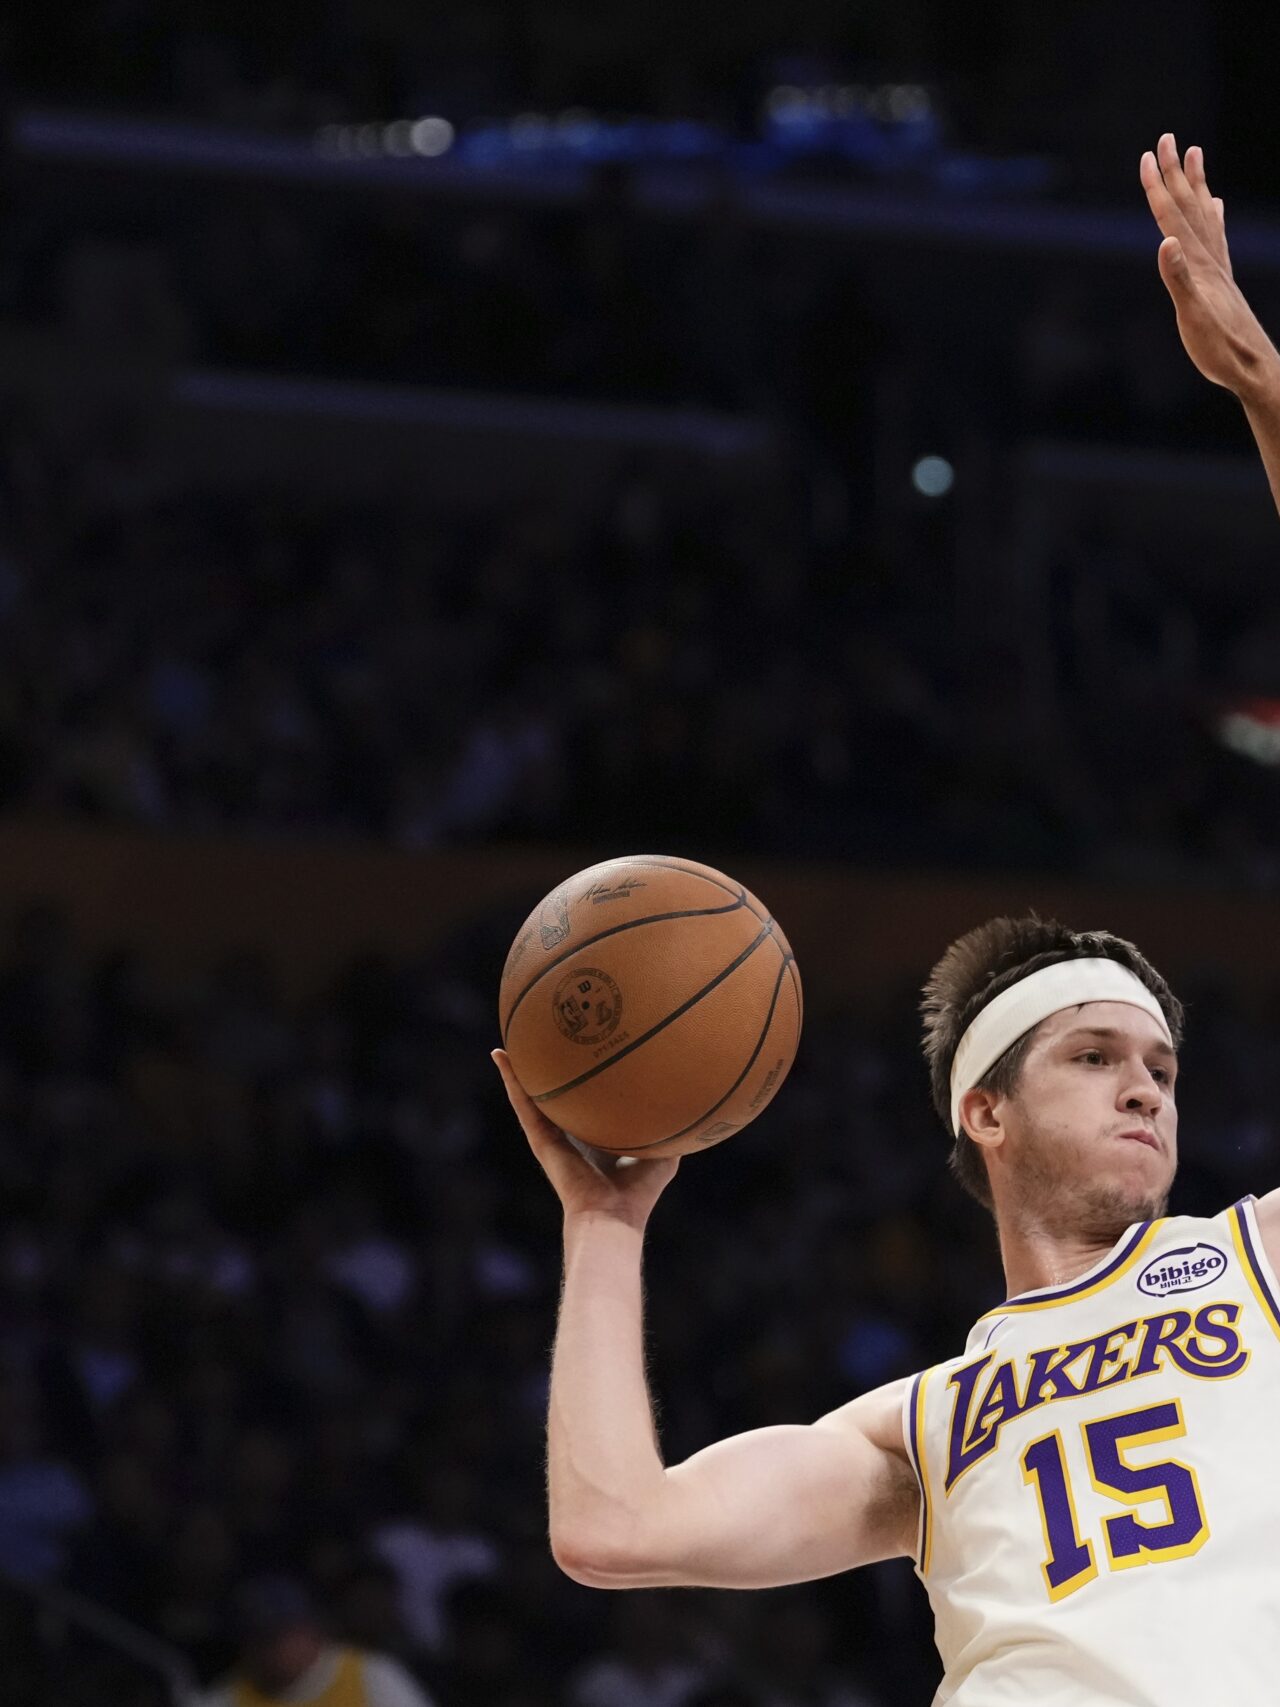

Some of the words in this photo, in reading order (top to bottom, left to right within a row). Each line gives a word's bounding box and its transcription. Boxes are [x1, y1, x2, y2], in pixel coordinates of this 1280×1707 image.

[1145, 1257, 1222, 1286] bibigo
[1160, 1276, 1192, 1289] 비비고
[945, 1301, 1251, 1498] LAKERS
[1019, 1397, 1210, 1604] 15
